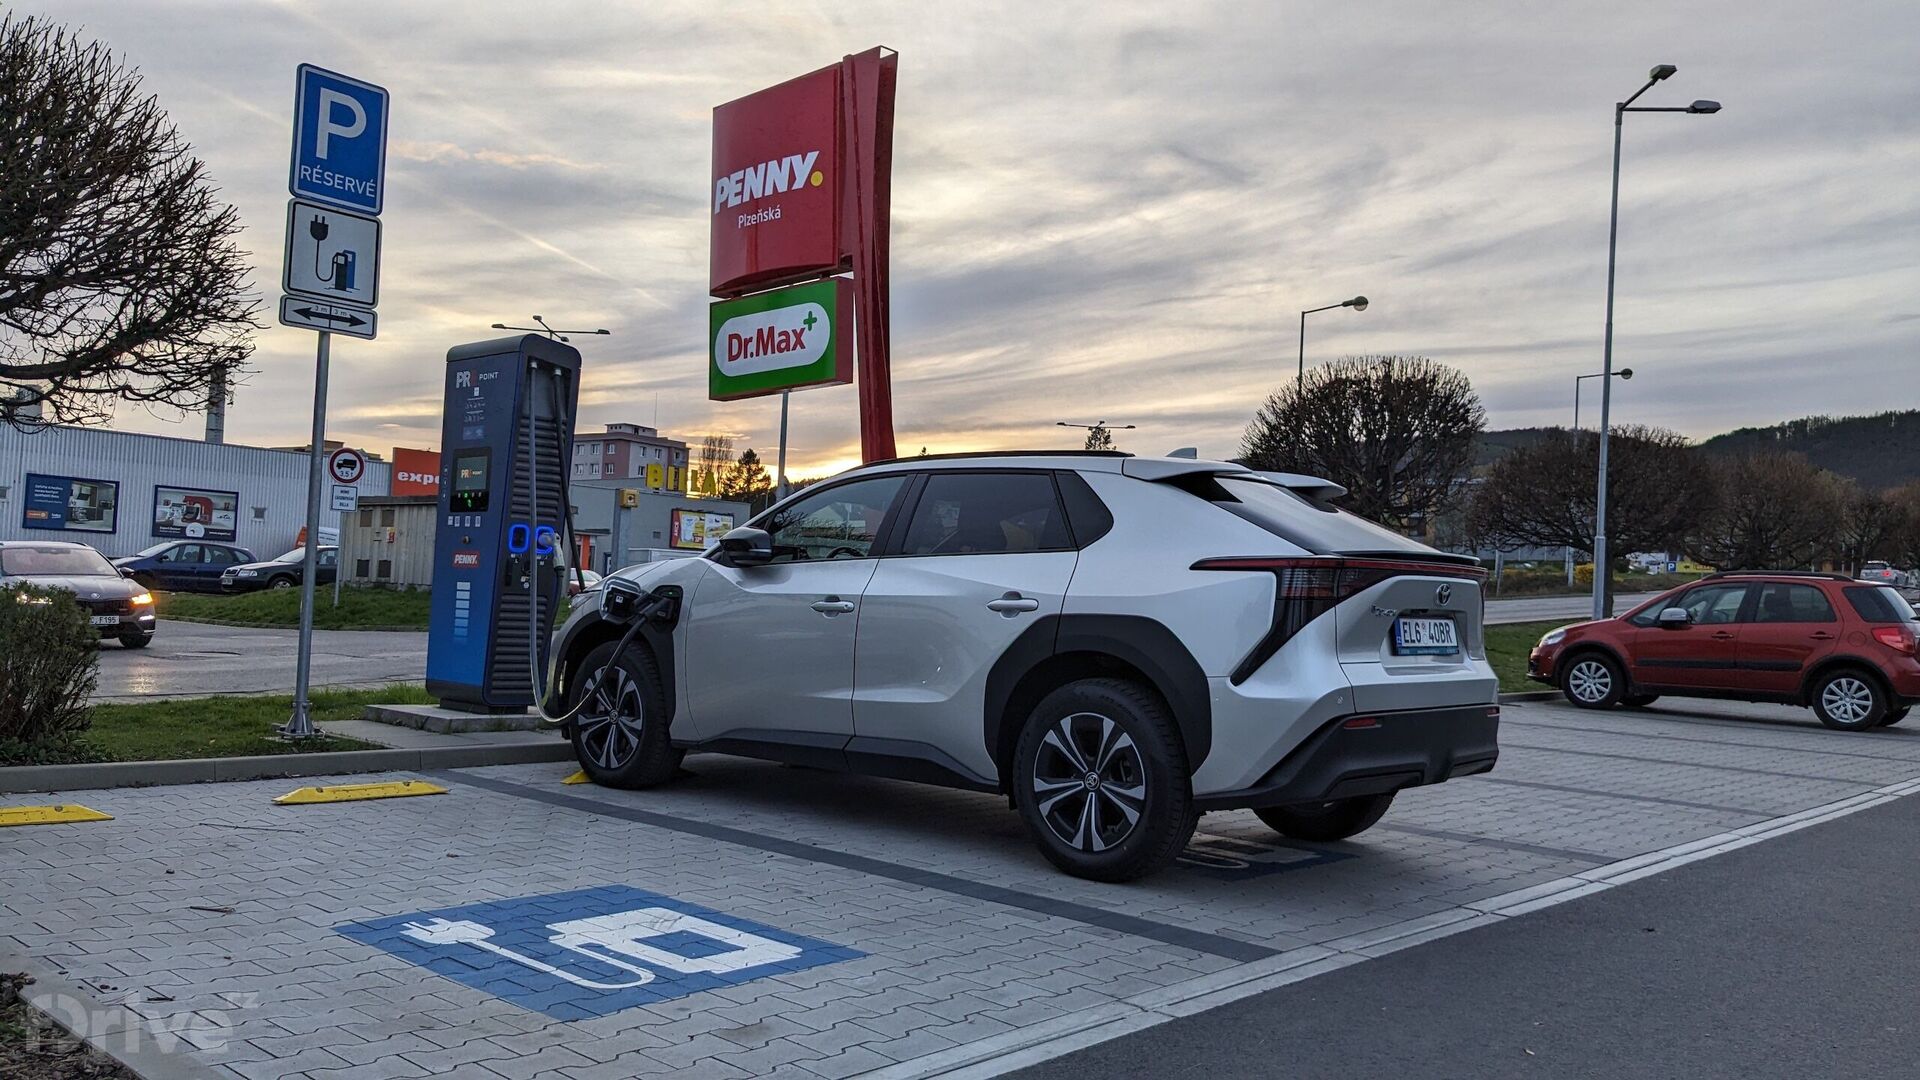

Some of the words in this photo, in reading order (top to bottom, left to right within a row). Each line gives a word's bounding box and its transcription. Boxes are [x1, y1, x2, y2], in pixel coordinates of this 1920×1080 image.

[315, 87, 368, 160] P
[300, 164, 376, 198] RÉSERVÉ
[738, 205, 782, 229] Plzeňská
[479, 371, 499, 381] POINT
[339, 470, 349, 478] 3,5
[1667, 562, 1675, 571] P
[1402, 621, 1422, 644] EL6
[1428, 621, 1453, 644] 40BR
